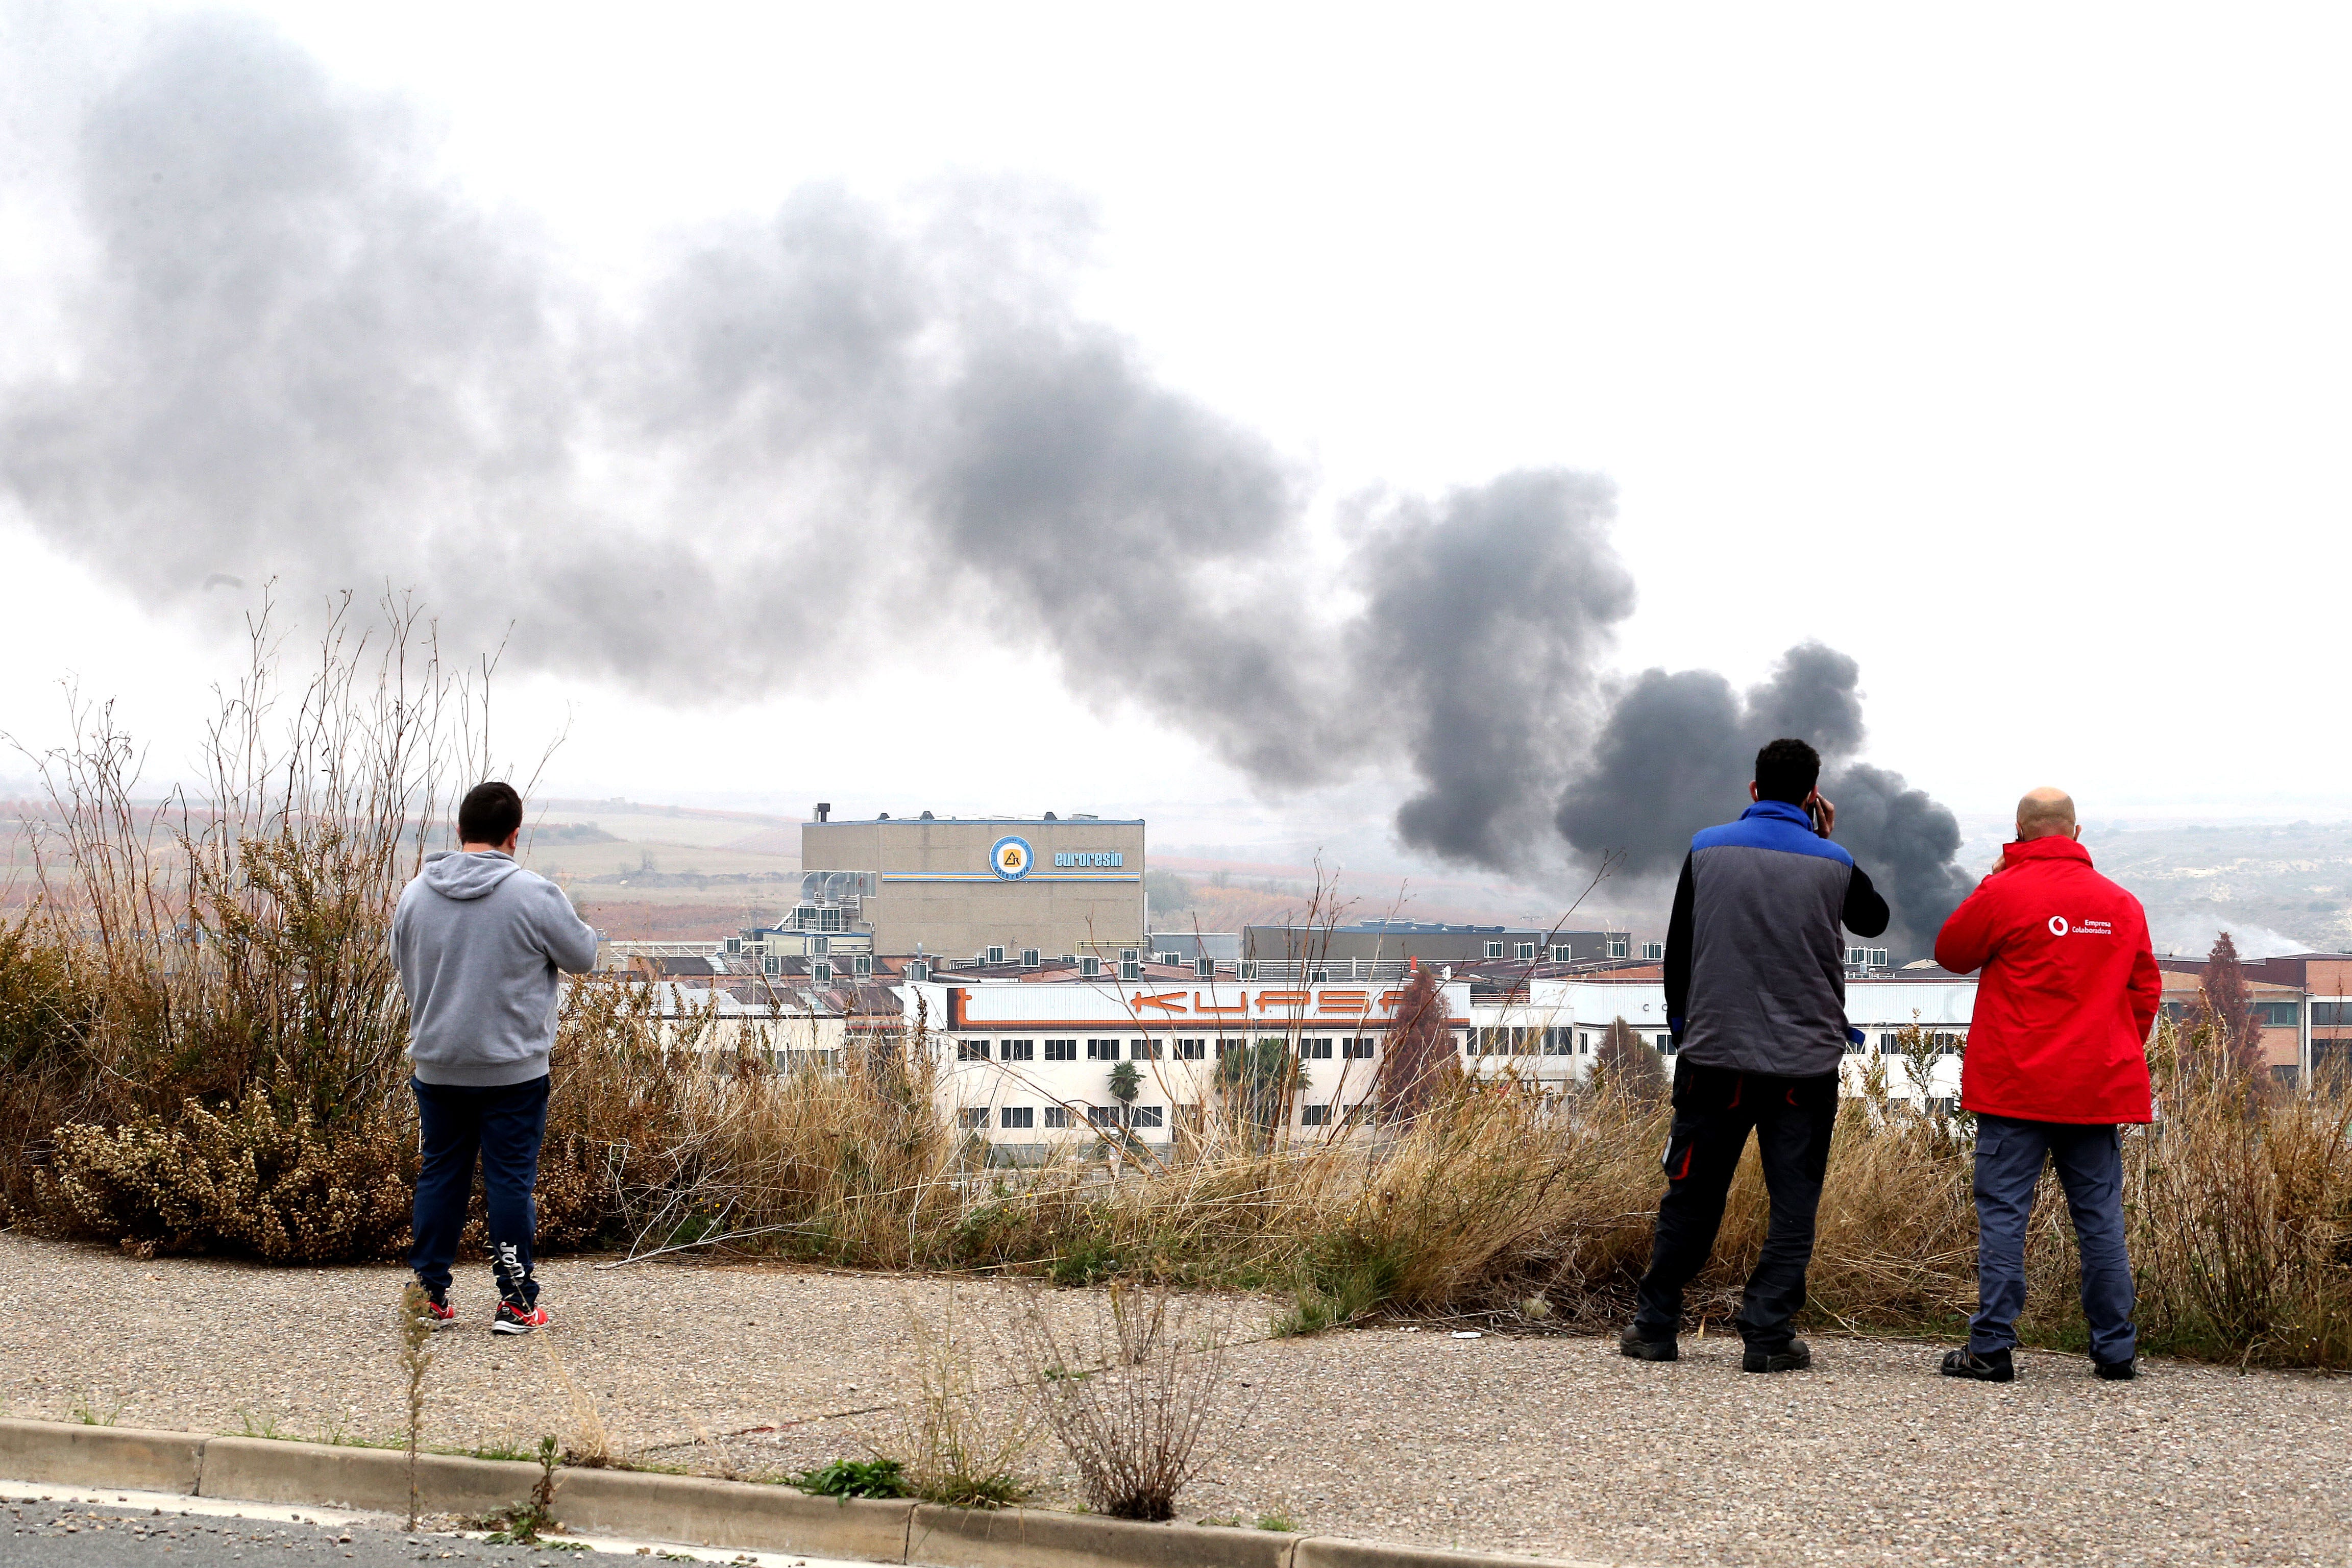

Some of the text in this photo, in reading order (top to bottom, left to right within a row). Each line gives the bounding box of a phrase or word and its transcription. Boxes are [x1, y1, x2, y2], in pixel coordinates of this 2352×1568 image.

[1055, 850, 1122, 867] euroresin
[995, 866, 1029, 879] euroresin
[2085, 919, 2111, 927] Empresa
[2072, 926, 2111, 935] Colaboradora
